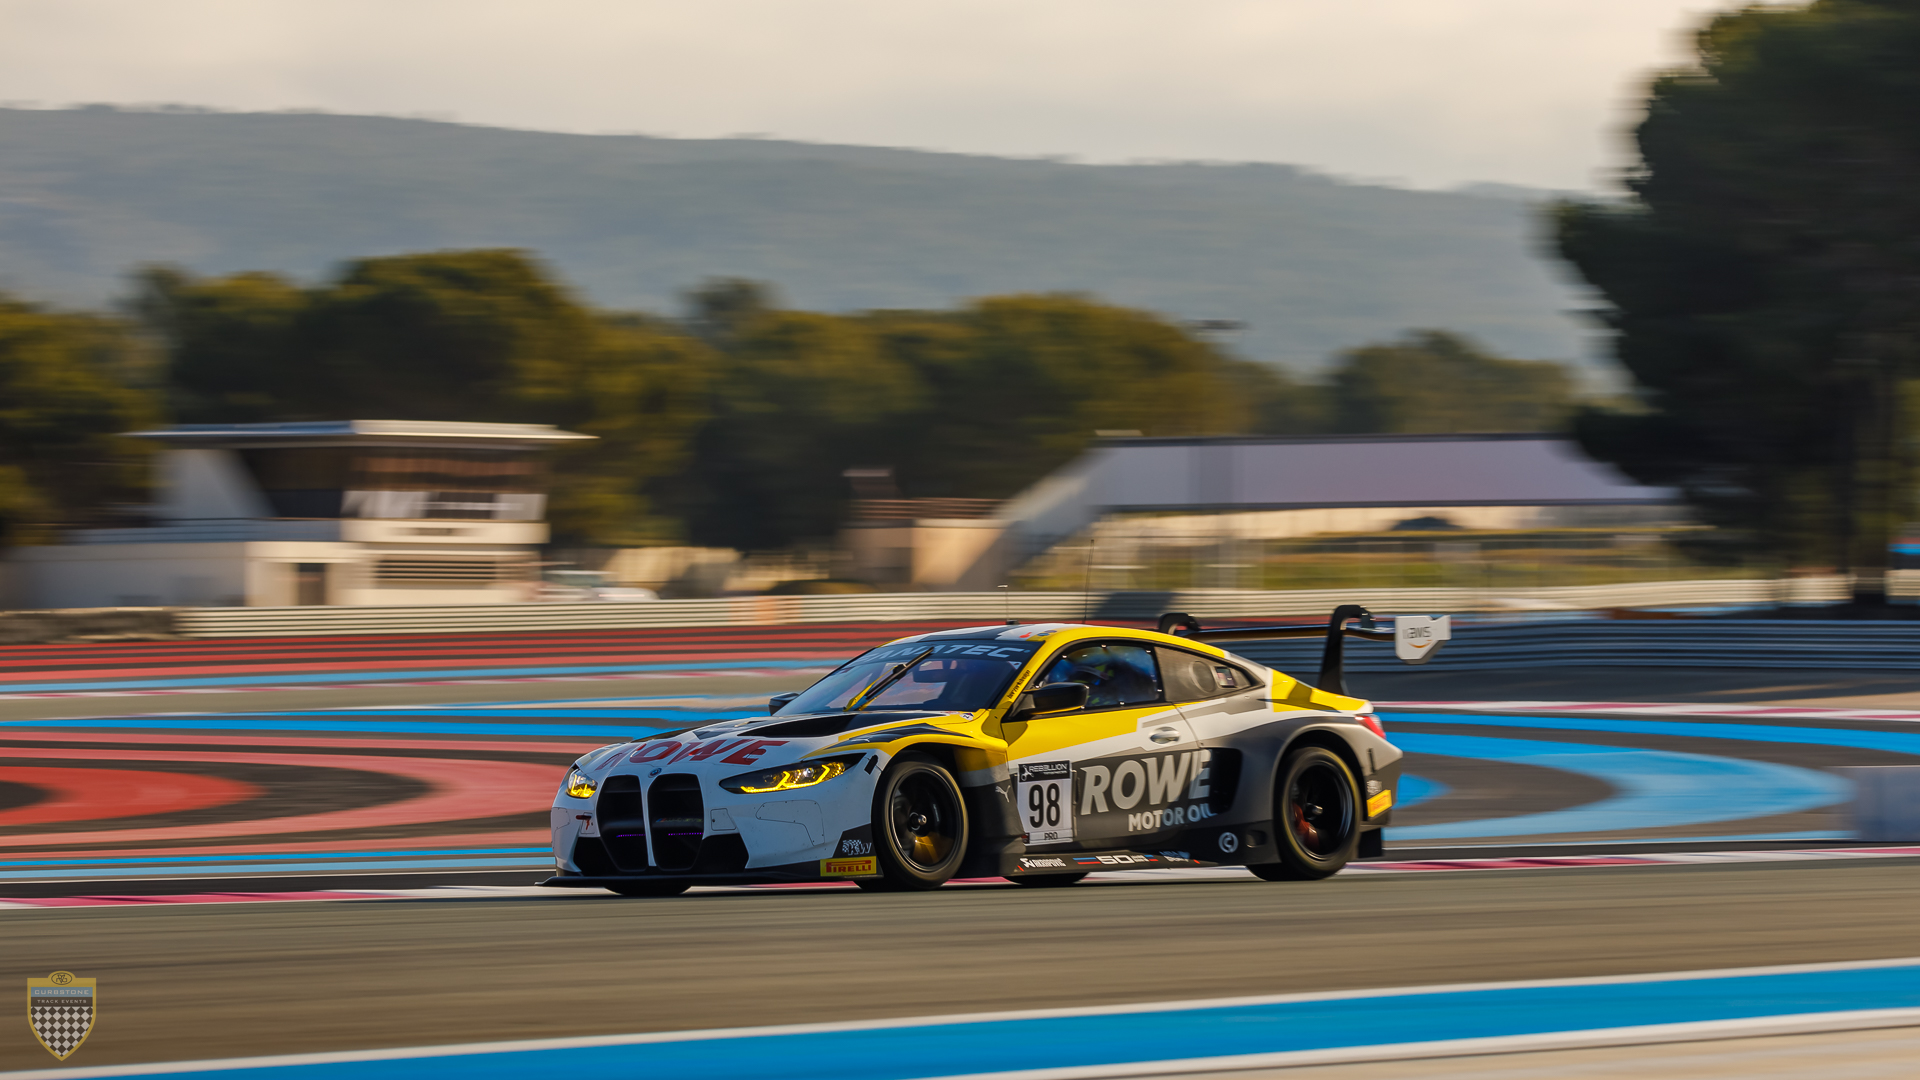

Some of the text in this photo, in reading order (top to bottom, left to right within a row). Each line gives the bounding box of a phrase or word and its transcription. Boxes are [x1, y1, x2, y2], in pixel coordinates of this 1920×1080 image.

[1029, 763, 1067, 772] REBELLION
[1080, 749, 1211, 815] ROWE
[1028, 782, 1060, 828] 98
[1128, 803, 1218, 832] MOTOR OIL
[1044, 832, 1058, 840] PRO
[826, 860, 872, 873] PIRELLI
